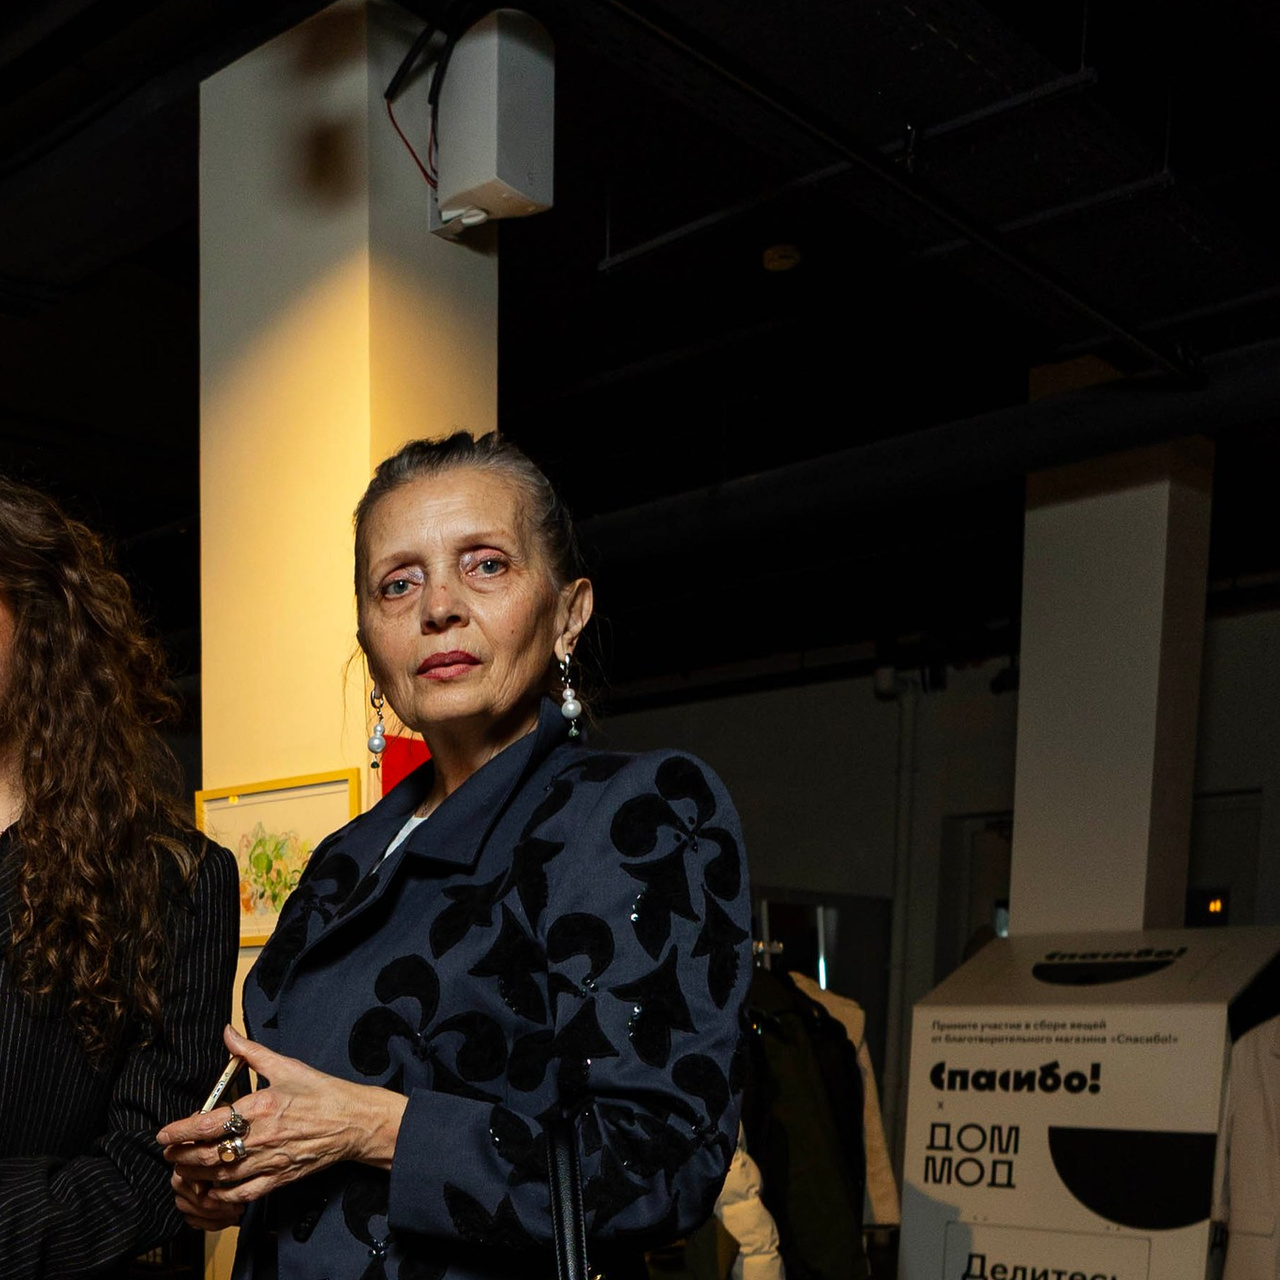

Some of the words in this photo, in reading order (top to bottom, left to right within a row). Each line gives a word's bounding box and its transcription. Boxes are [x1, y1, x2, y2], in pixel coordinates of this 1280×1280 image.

[1033, 1019, 1066, 1032] сборе
[930, 1061, 1101, 1094] Спасибо!
[926, 1122, 1020, 1155] ДОМ
[924, 1155, 1016, 1189] МОД
